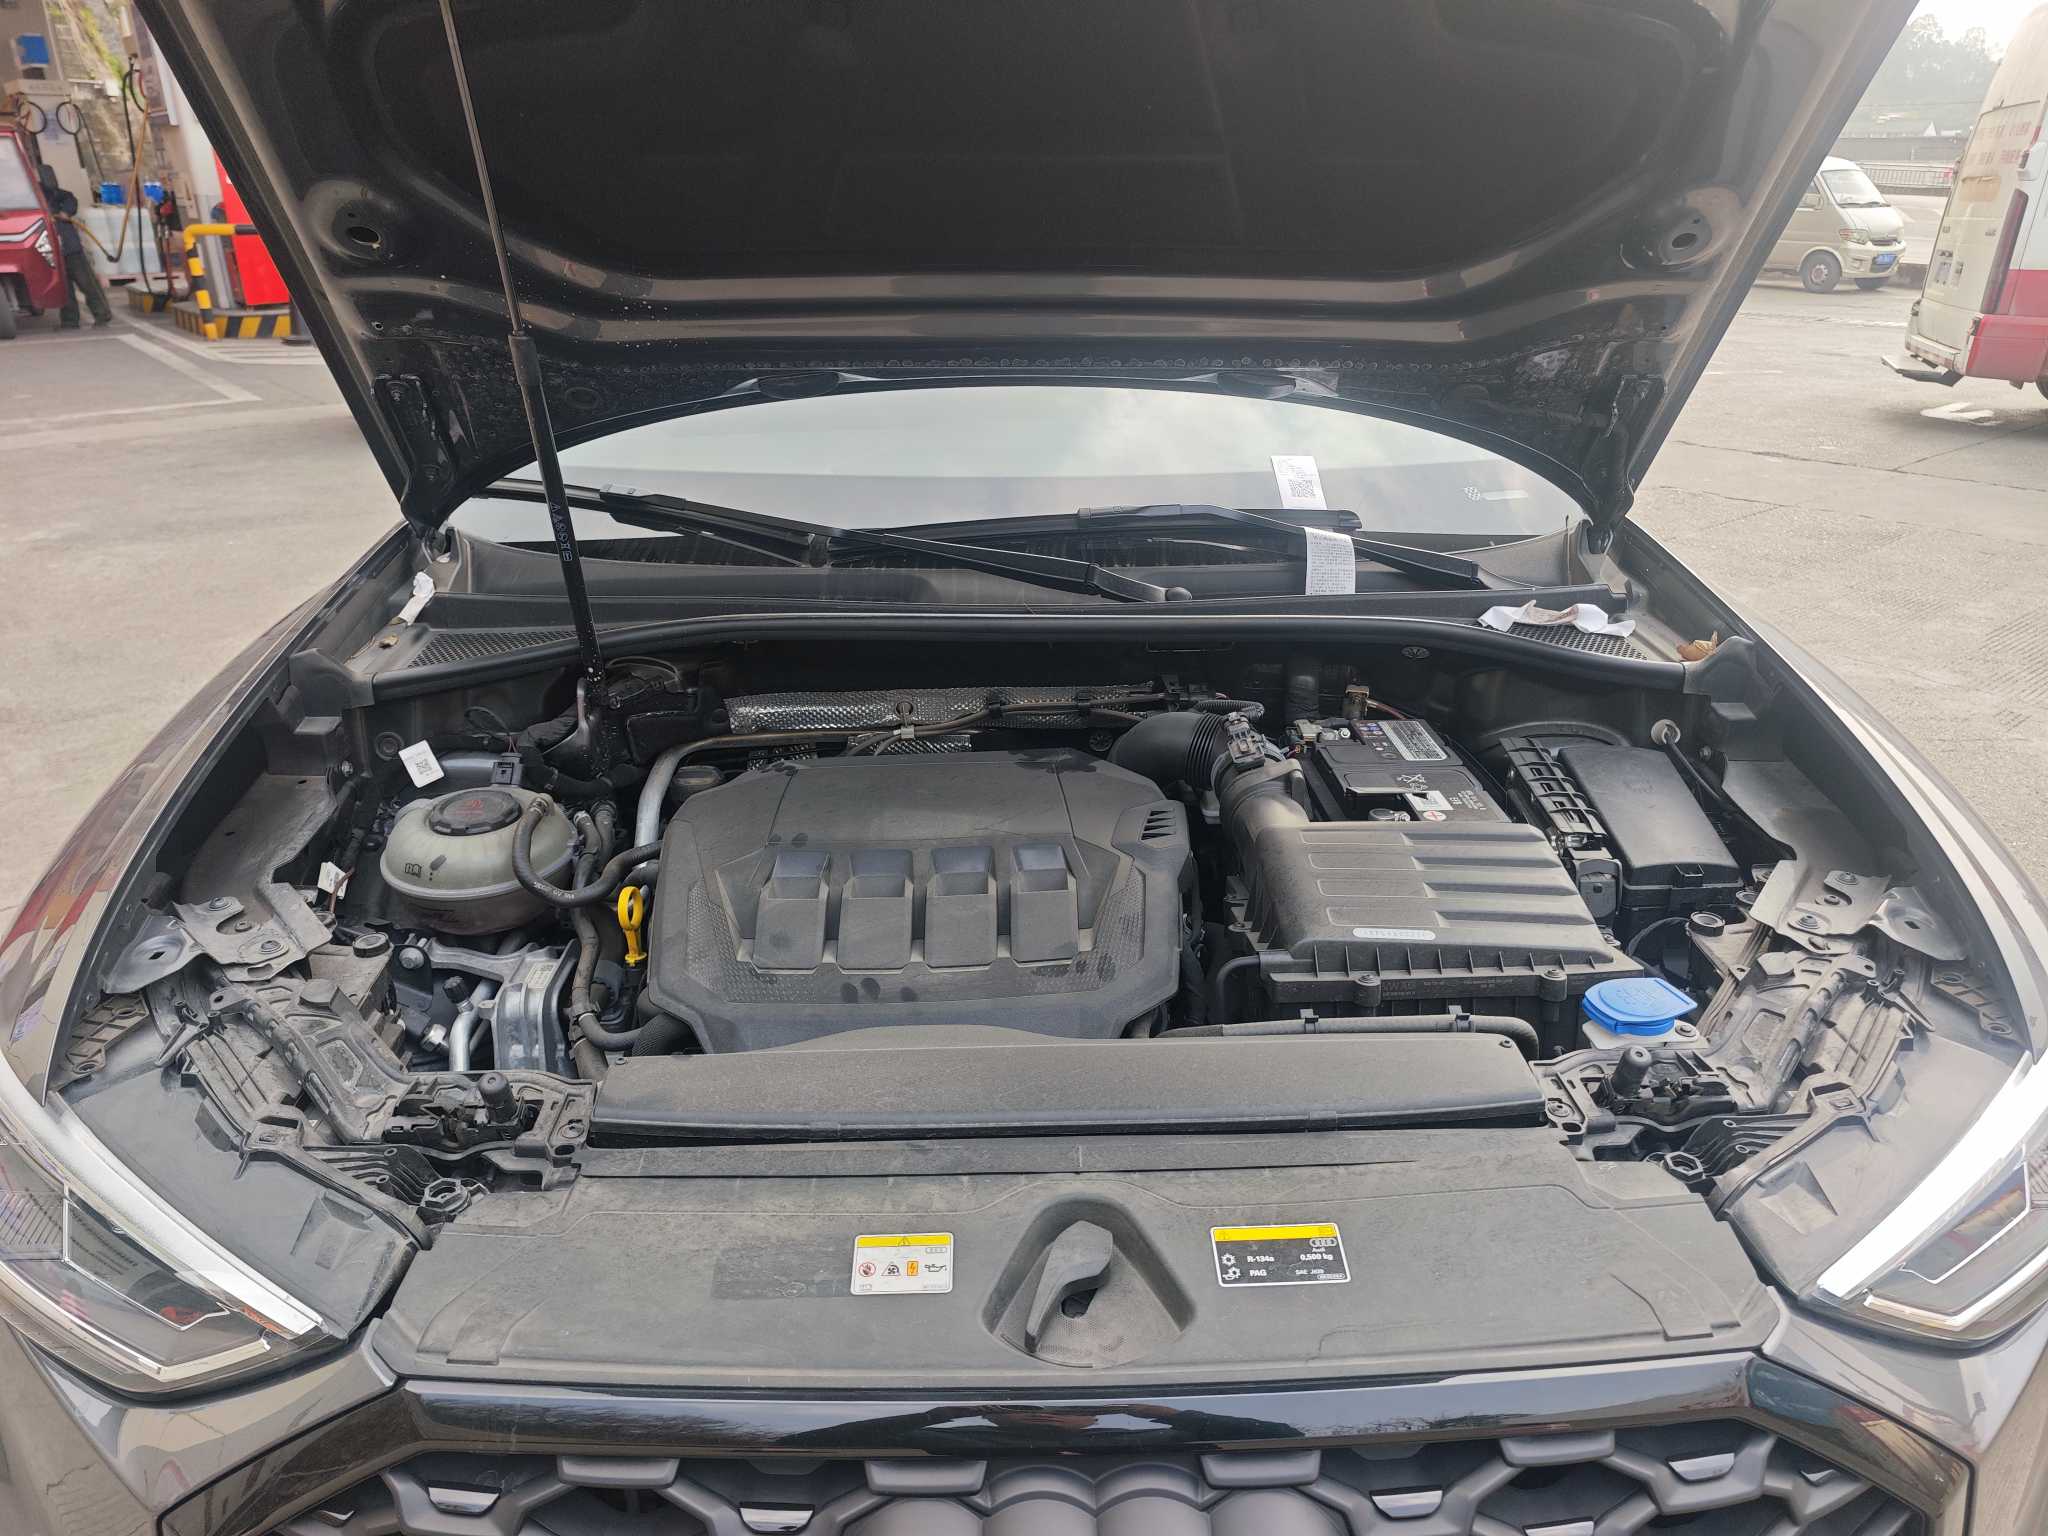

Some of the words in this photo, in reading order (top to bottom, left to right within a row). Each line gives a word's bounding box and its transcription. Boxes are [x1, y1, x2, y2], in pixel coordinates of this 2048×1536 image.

[1247, 1255, 1275, 1263] R-134a
[1322, 1253, 1333, 1261] kg
[1249, 1269, 1267, 1277] PAG
